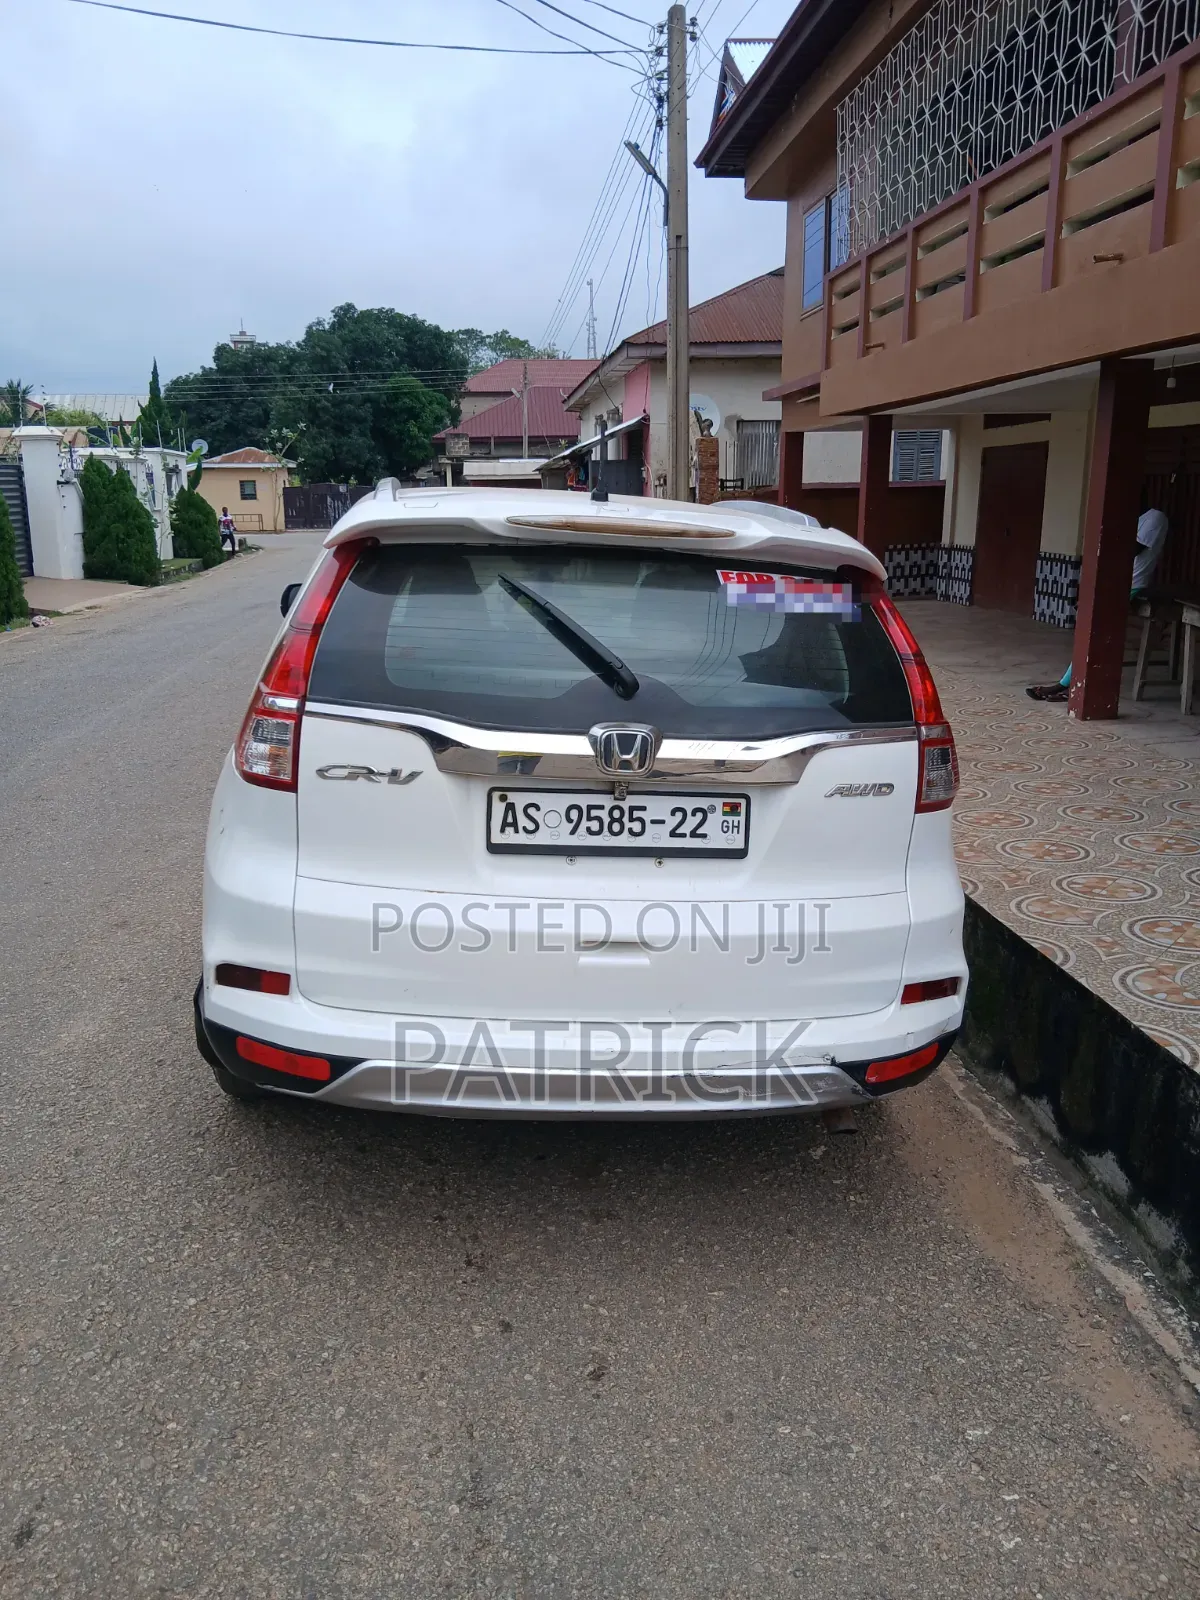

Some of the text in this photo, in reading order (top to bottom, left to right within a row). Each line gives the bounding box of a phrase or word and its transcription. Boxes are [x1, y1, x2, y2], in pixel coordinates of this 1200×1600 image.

[824, 783, 895, 798] AWD
[500, 802, 541, 835] AS
[721, 819, 741, 835] GH
